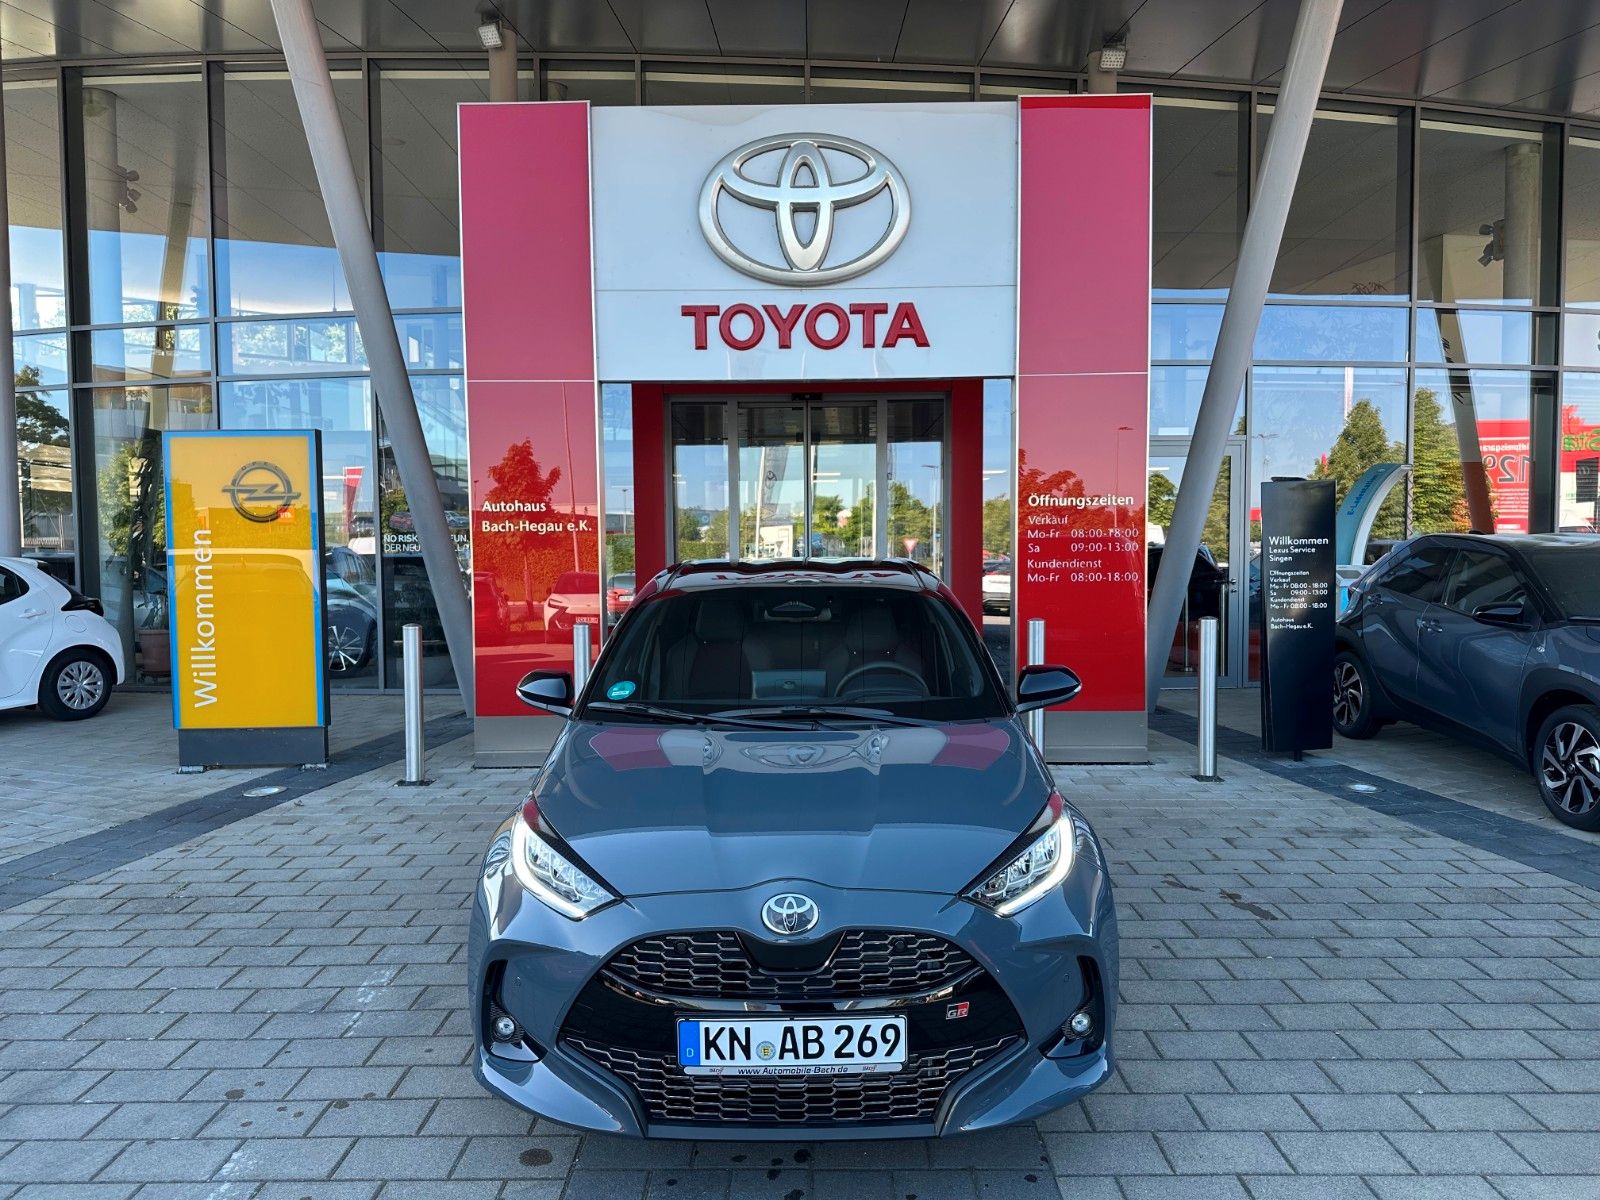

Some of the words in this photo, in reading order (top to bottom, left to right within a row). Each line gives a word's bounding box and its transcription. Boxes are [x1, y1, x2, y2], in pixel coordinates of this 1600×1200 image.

[681, 302, 931, 351] TOYOTA
[481, 500, 547, 512] Autohaus
[1028, 493, 1134, 509] Öffnungszeiten
[1028, 515, 1068, 525] Verkauf
[481, 520, 563, 535] Bach-Hegau
[567, 519, 592, 532] e.K.
[383, 534, 397, 542] NO
[1027, 529, 1060, 539] Mo-Fr
[1070, 528, 1139, 538] 08:00-18:00
[1268, 536, 1329, 546] Willkommen
[384, 544, 401, 552] DER
[403, 544, 421, 552] NEU
[1028, 543, 1040, 553] Sa
[1070, 542, 1139, 552] 09:00-13:00
[1269, 546, 1289, 554] Lexus
[1027, 559, 1102, 568] Kundendienst
[1269, 554, 1293, 563] Singen
[1027, 573, 1060, 582] Mo-Fr
[1070, 572, 1139, 581] 08:00-18:00
[190, 529, 218, 708] Willkommen
[686, 1048, 694, 1058] D
[704, 1026, 751, 1060] KN
[778, 1025, 826, 1060] AB
[834, 1023, 902, 1059] 269
